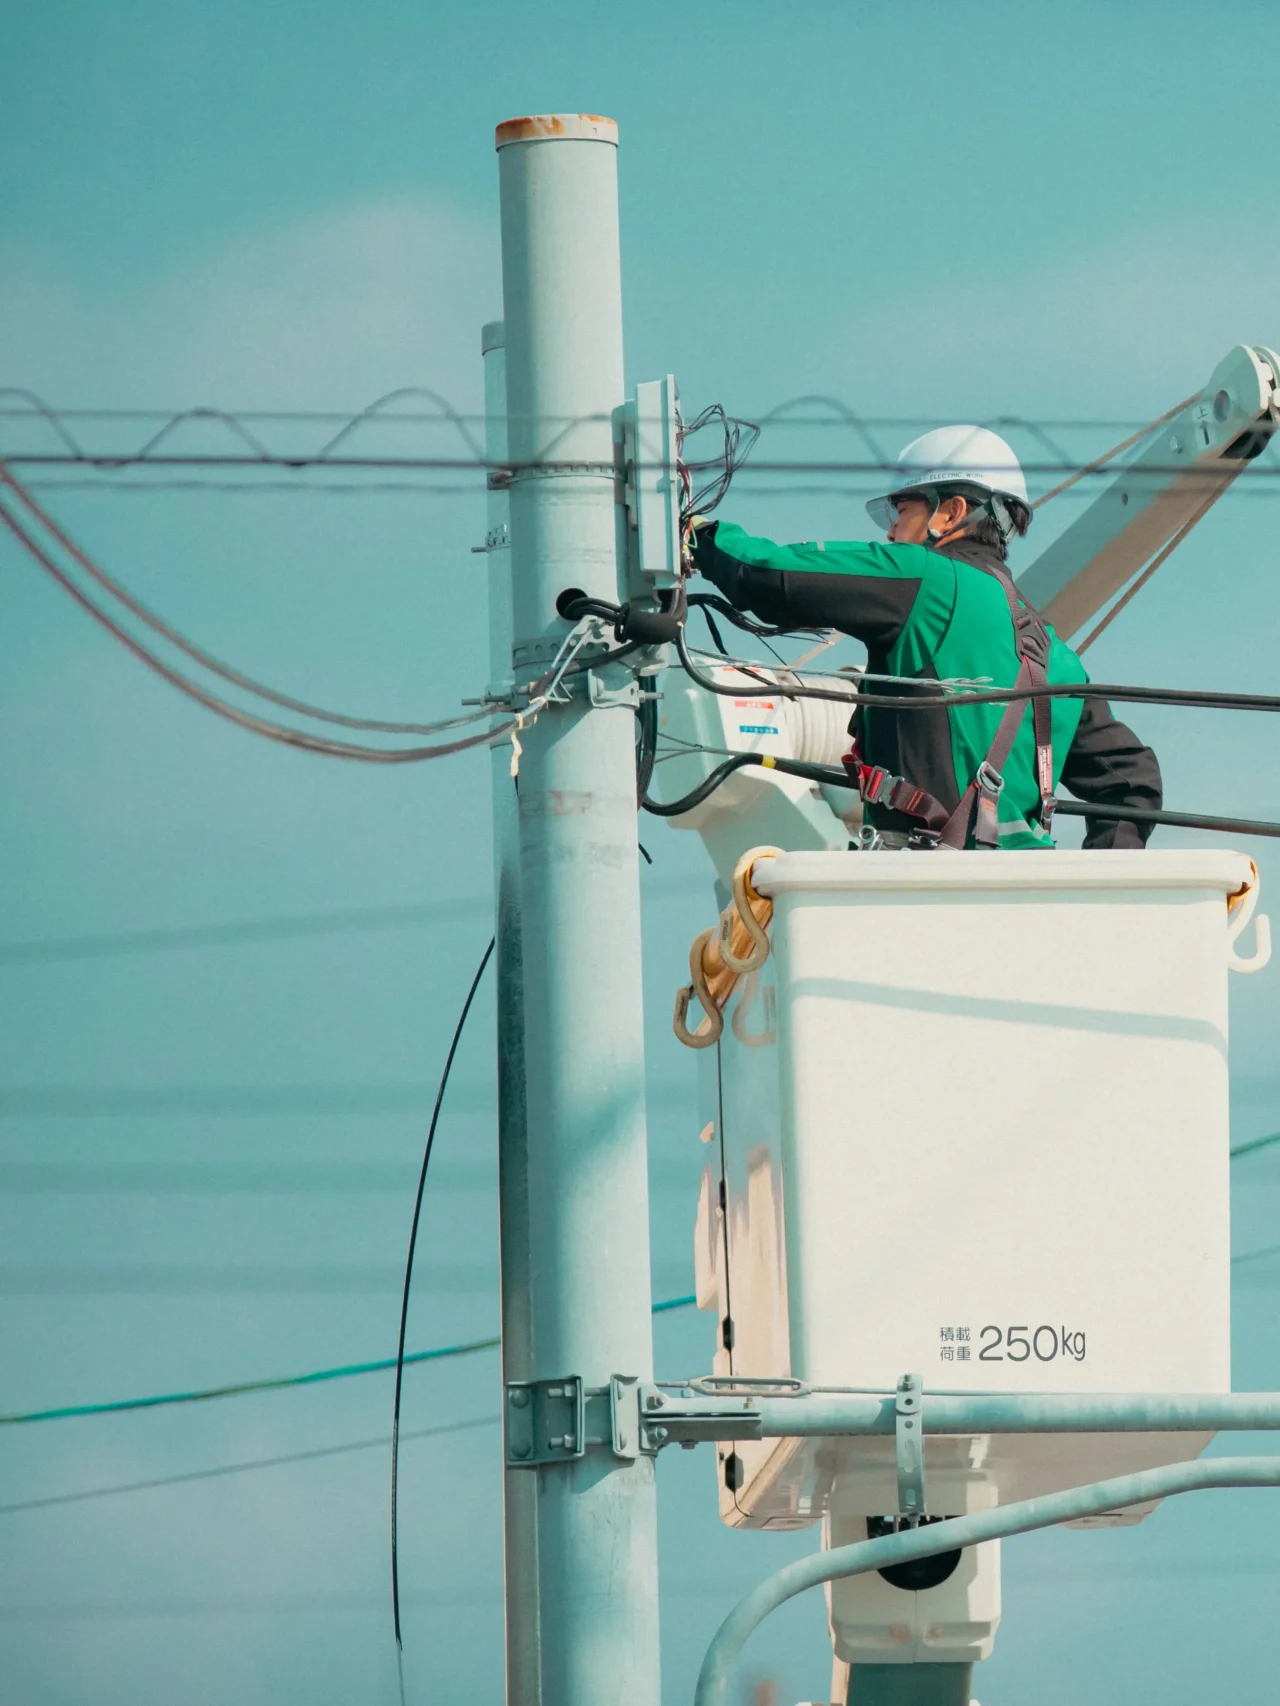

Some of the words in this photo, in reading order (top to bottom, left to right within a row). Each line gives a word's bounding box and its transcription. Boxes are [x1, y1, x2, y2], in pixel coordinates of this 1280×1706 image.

[1197, 406, 1209, 420] 上
[929, 472, 962, 481] ELECTRIC
[939, 1326, 971, 1342] 積載
[978, 1325, 1085, 1361] 250kg
[939, 1346, 971, 1361] 荷重
